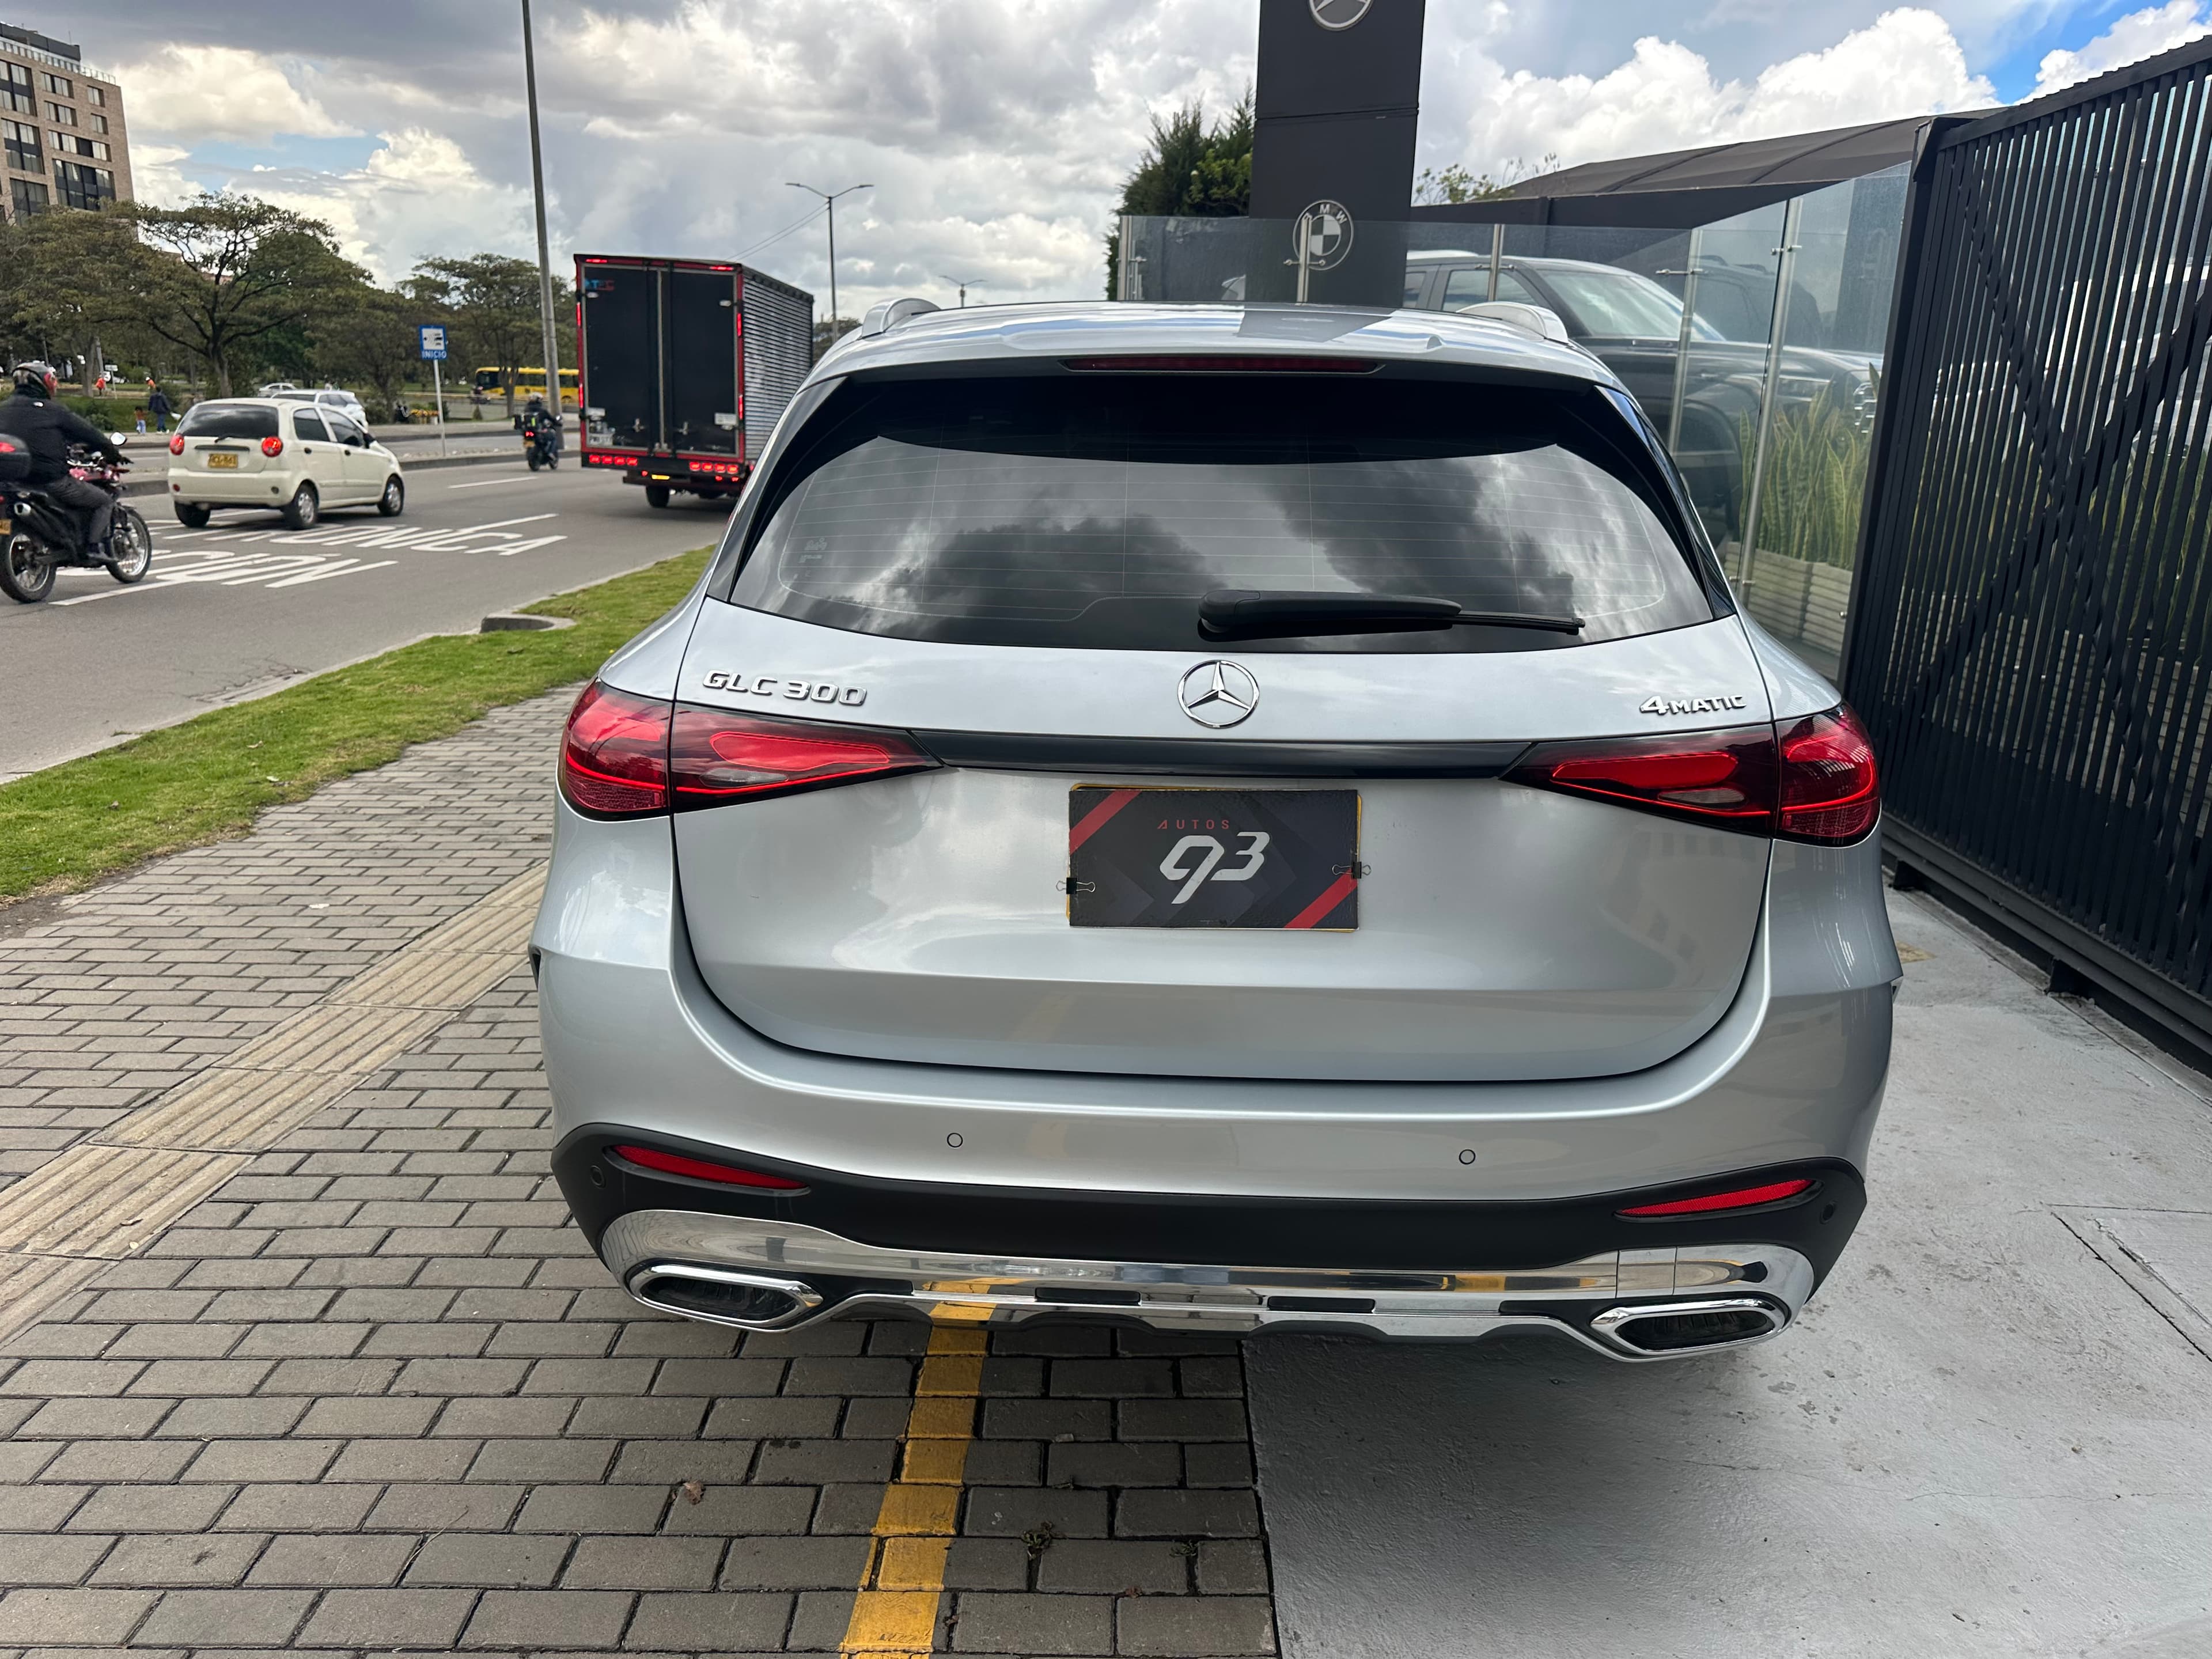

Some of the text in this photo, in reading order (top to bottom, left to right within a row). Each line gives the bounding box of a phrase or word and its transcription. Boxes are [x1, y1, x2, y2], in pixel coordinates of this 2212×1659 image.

[421, 350, 447, 359] INICIO
[702, 669, 867, 706] GLC 300
[1639, 695, 1747, 716] 4MATIC
[1157, 820, 1230, 830] AUTOS
[1159, 831, 1270, 904] 93
